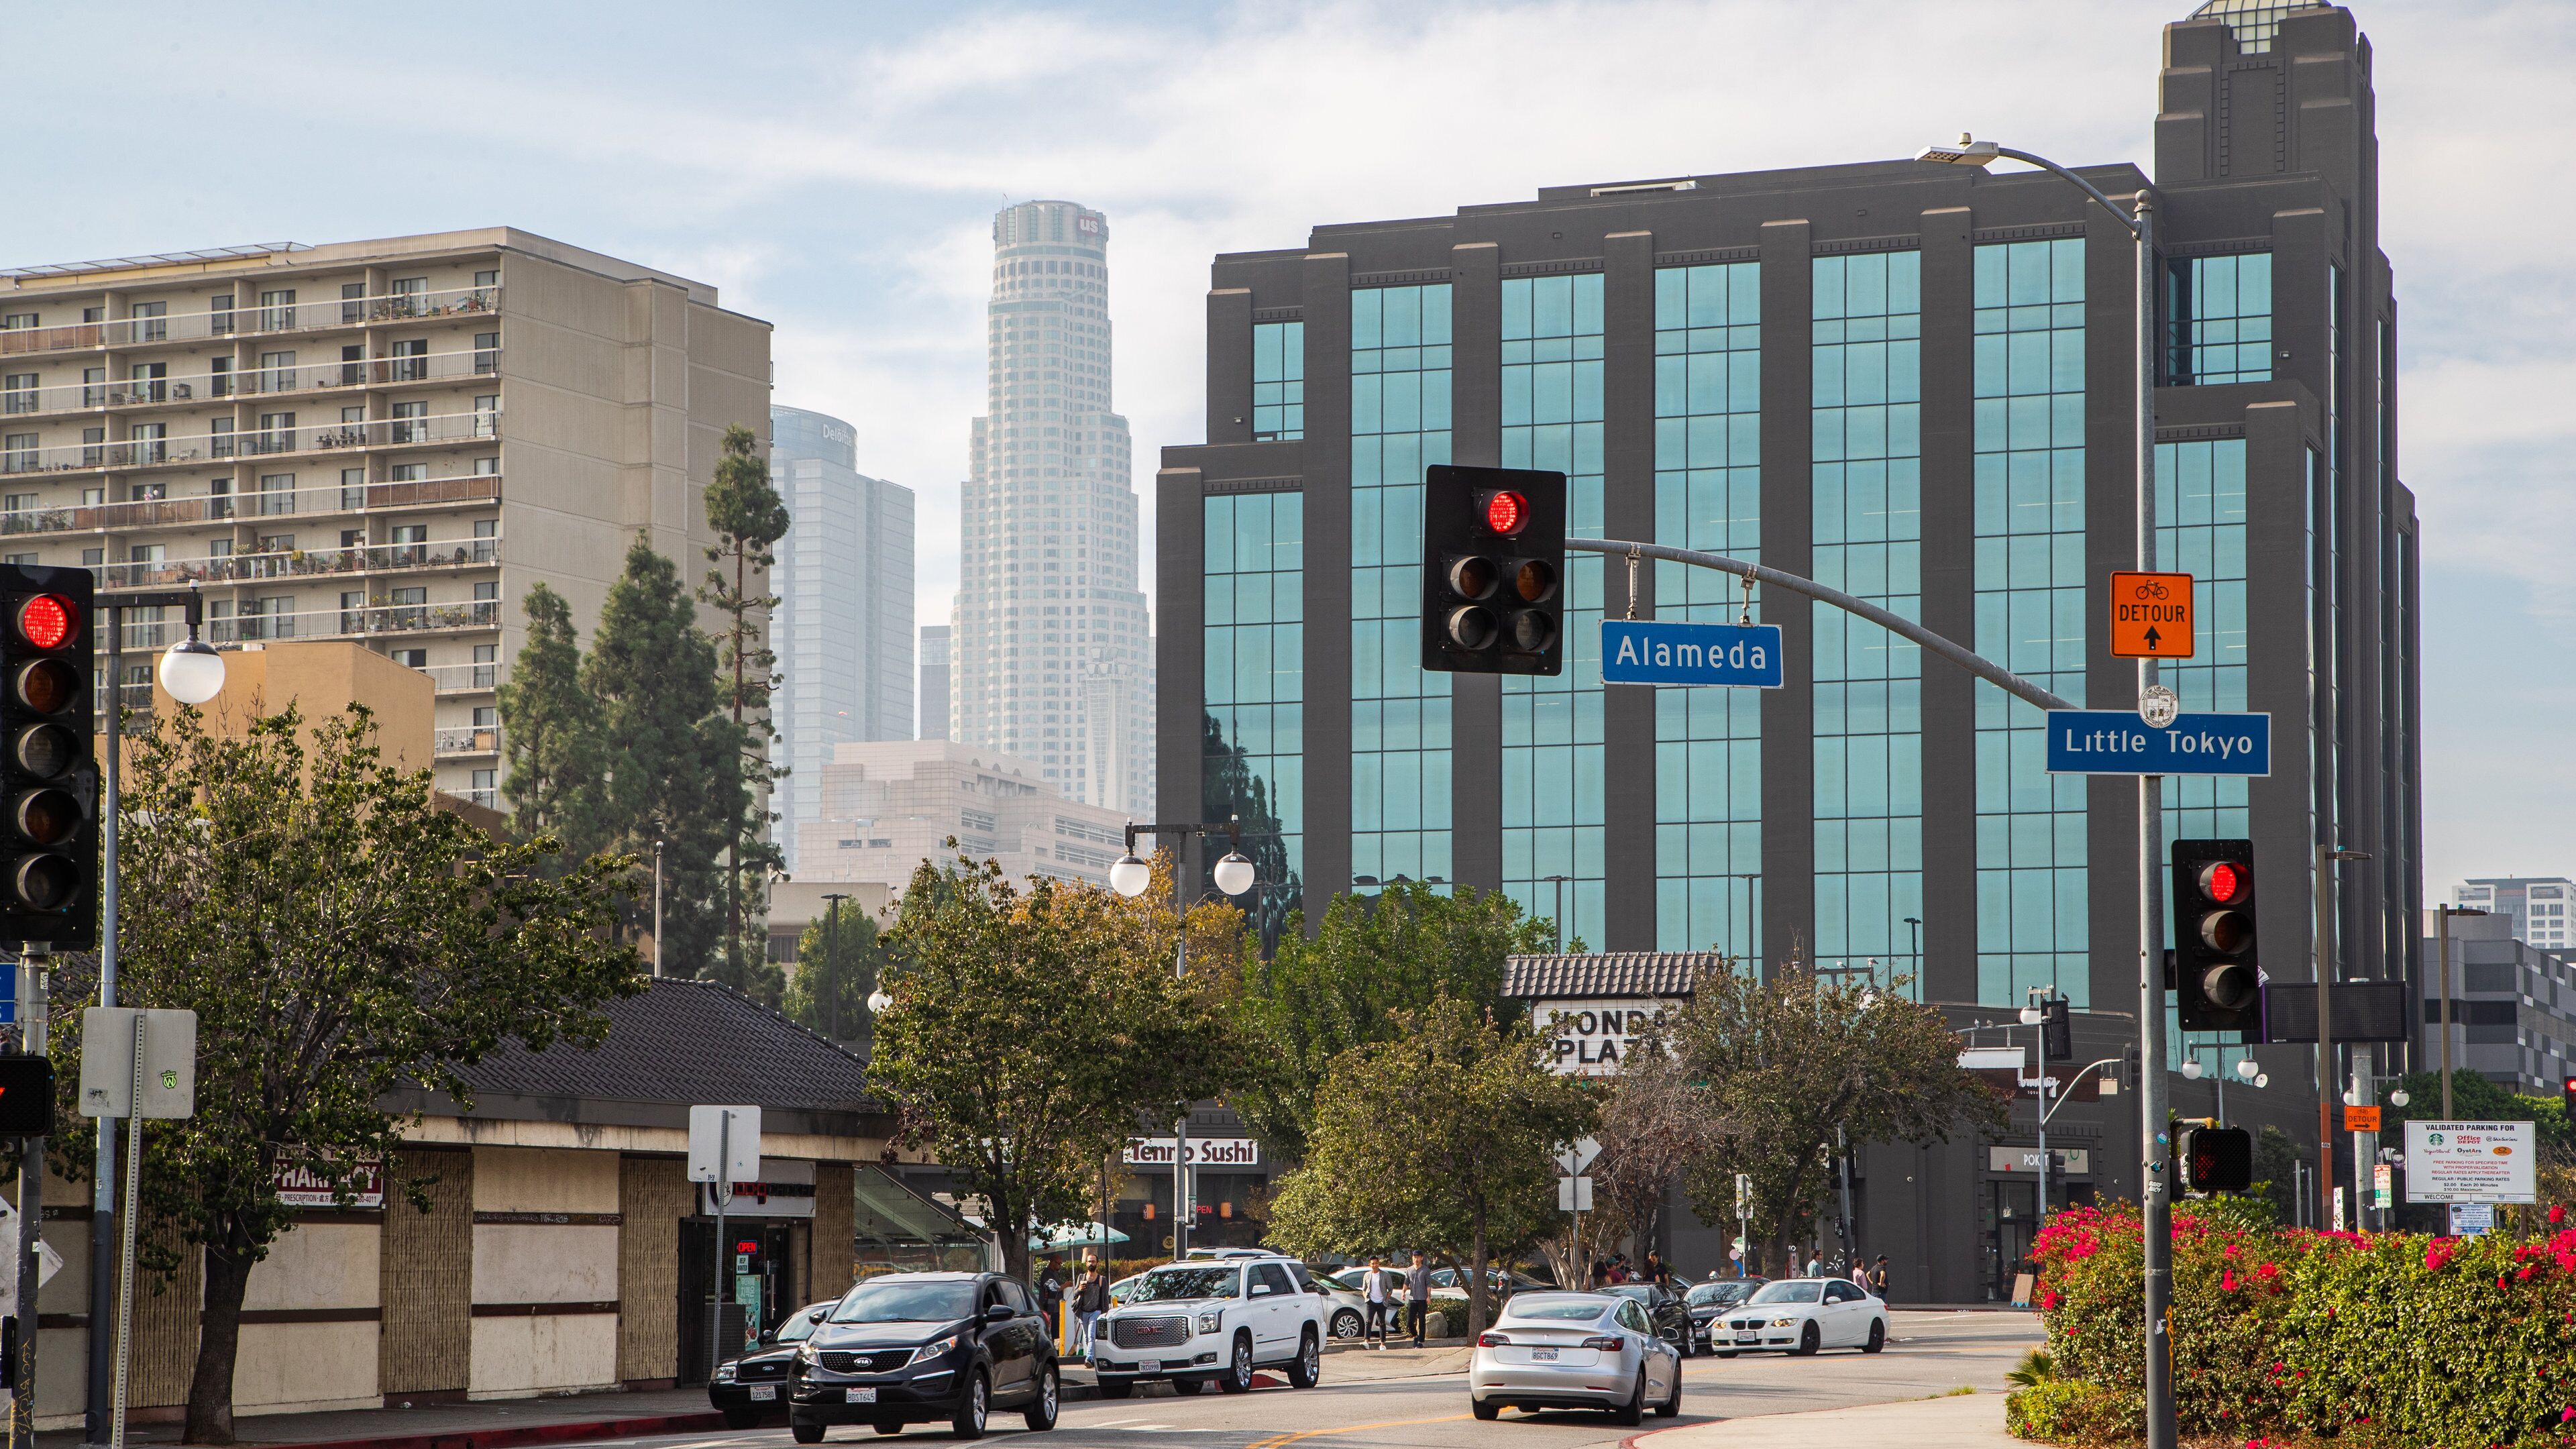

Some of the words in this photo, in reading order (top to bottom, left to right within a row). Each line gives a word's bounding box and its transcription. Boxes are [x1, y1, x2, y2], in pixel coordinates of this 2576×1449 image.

[823, 423, 851, 447] Deloitte
[2120, 605, 2185, 622] DETOUR
[1616, 635, 1766, 669] Alameda
[2066, 729, 2146, 752] Little
[2165, 731, 2253, 759] Tokyo
[1556, 1040, 1640, 1064] PLAZ
[1201, 1140, 1254, 1162] Sushi
[284, 1193, 317, 1203] PRESCRIPTION
[1197, 1205, 1212, 1214] PEN
[738, 1242, 756, 1252] OPEN
[1533, 1352, 1558, 1360] 8GCT869
[752, 1391, 774, 1399] 1217580
[847, 1393, 875, 1401] 8DST645
